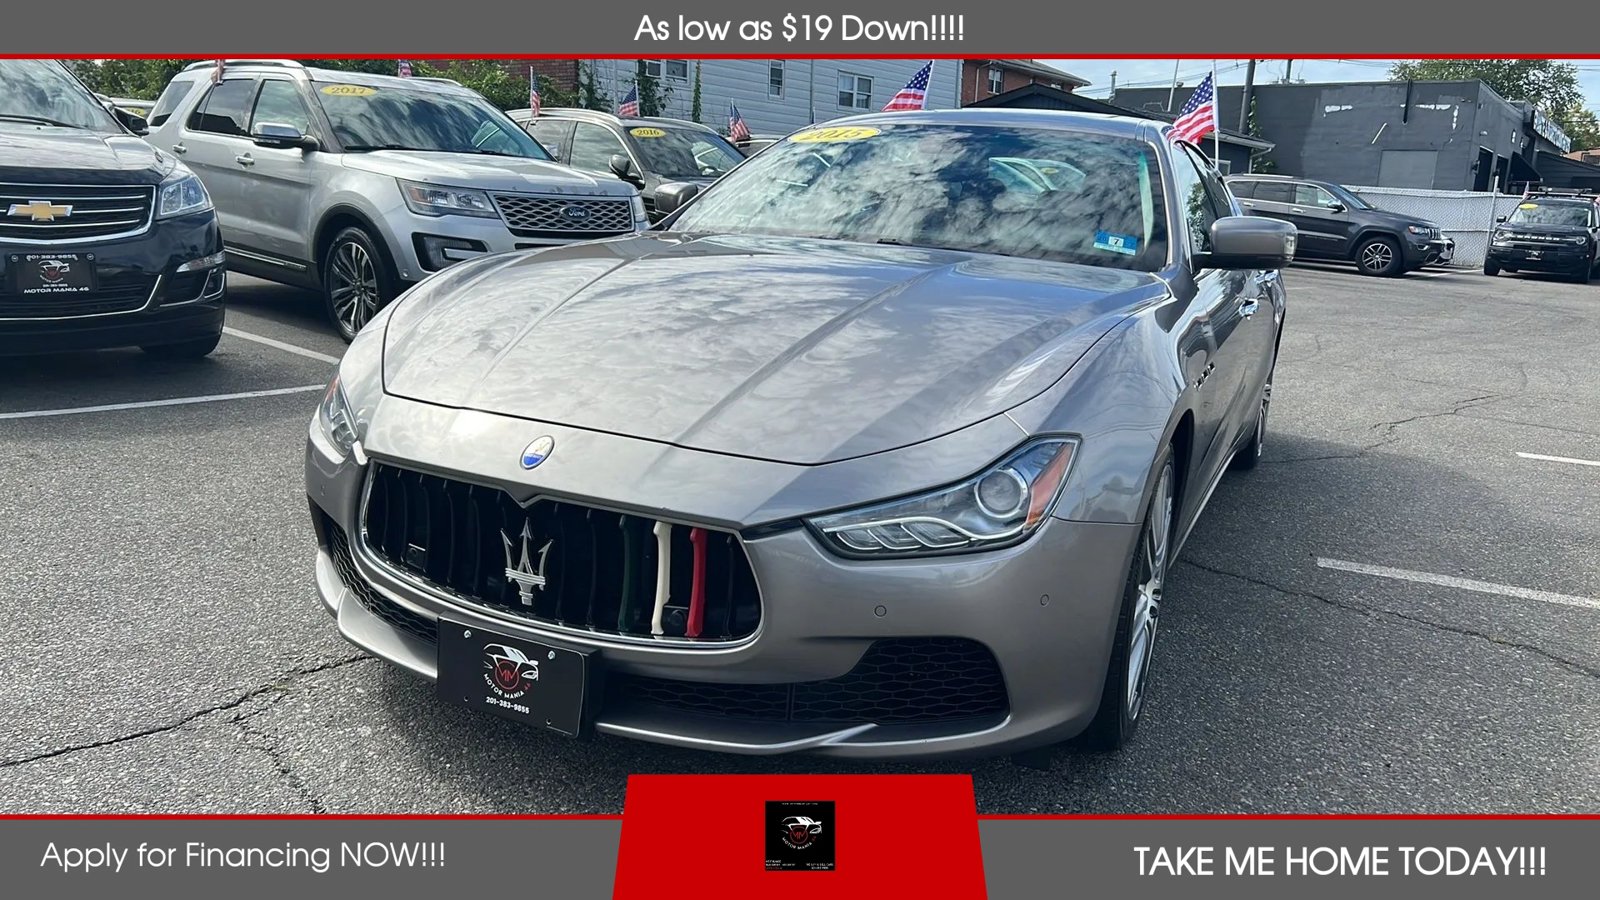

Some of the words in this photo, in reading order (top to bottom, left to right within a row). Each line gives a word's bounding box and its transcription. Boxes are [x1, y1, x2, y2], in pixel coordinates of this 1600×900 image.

[331, 86, 366, 94] 2017
[483, 673, 503, 696] MOTOR
[503, 690, 525, 699] MANIA
[485, 696, 530, 714] 201-383-9855
